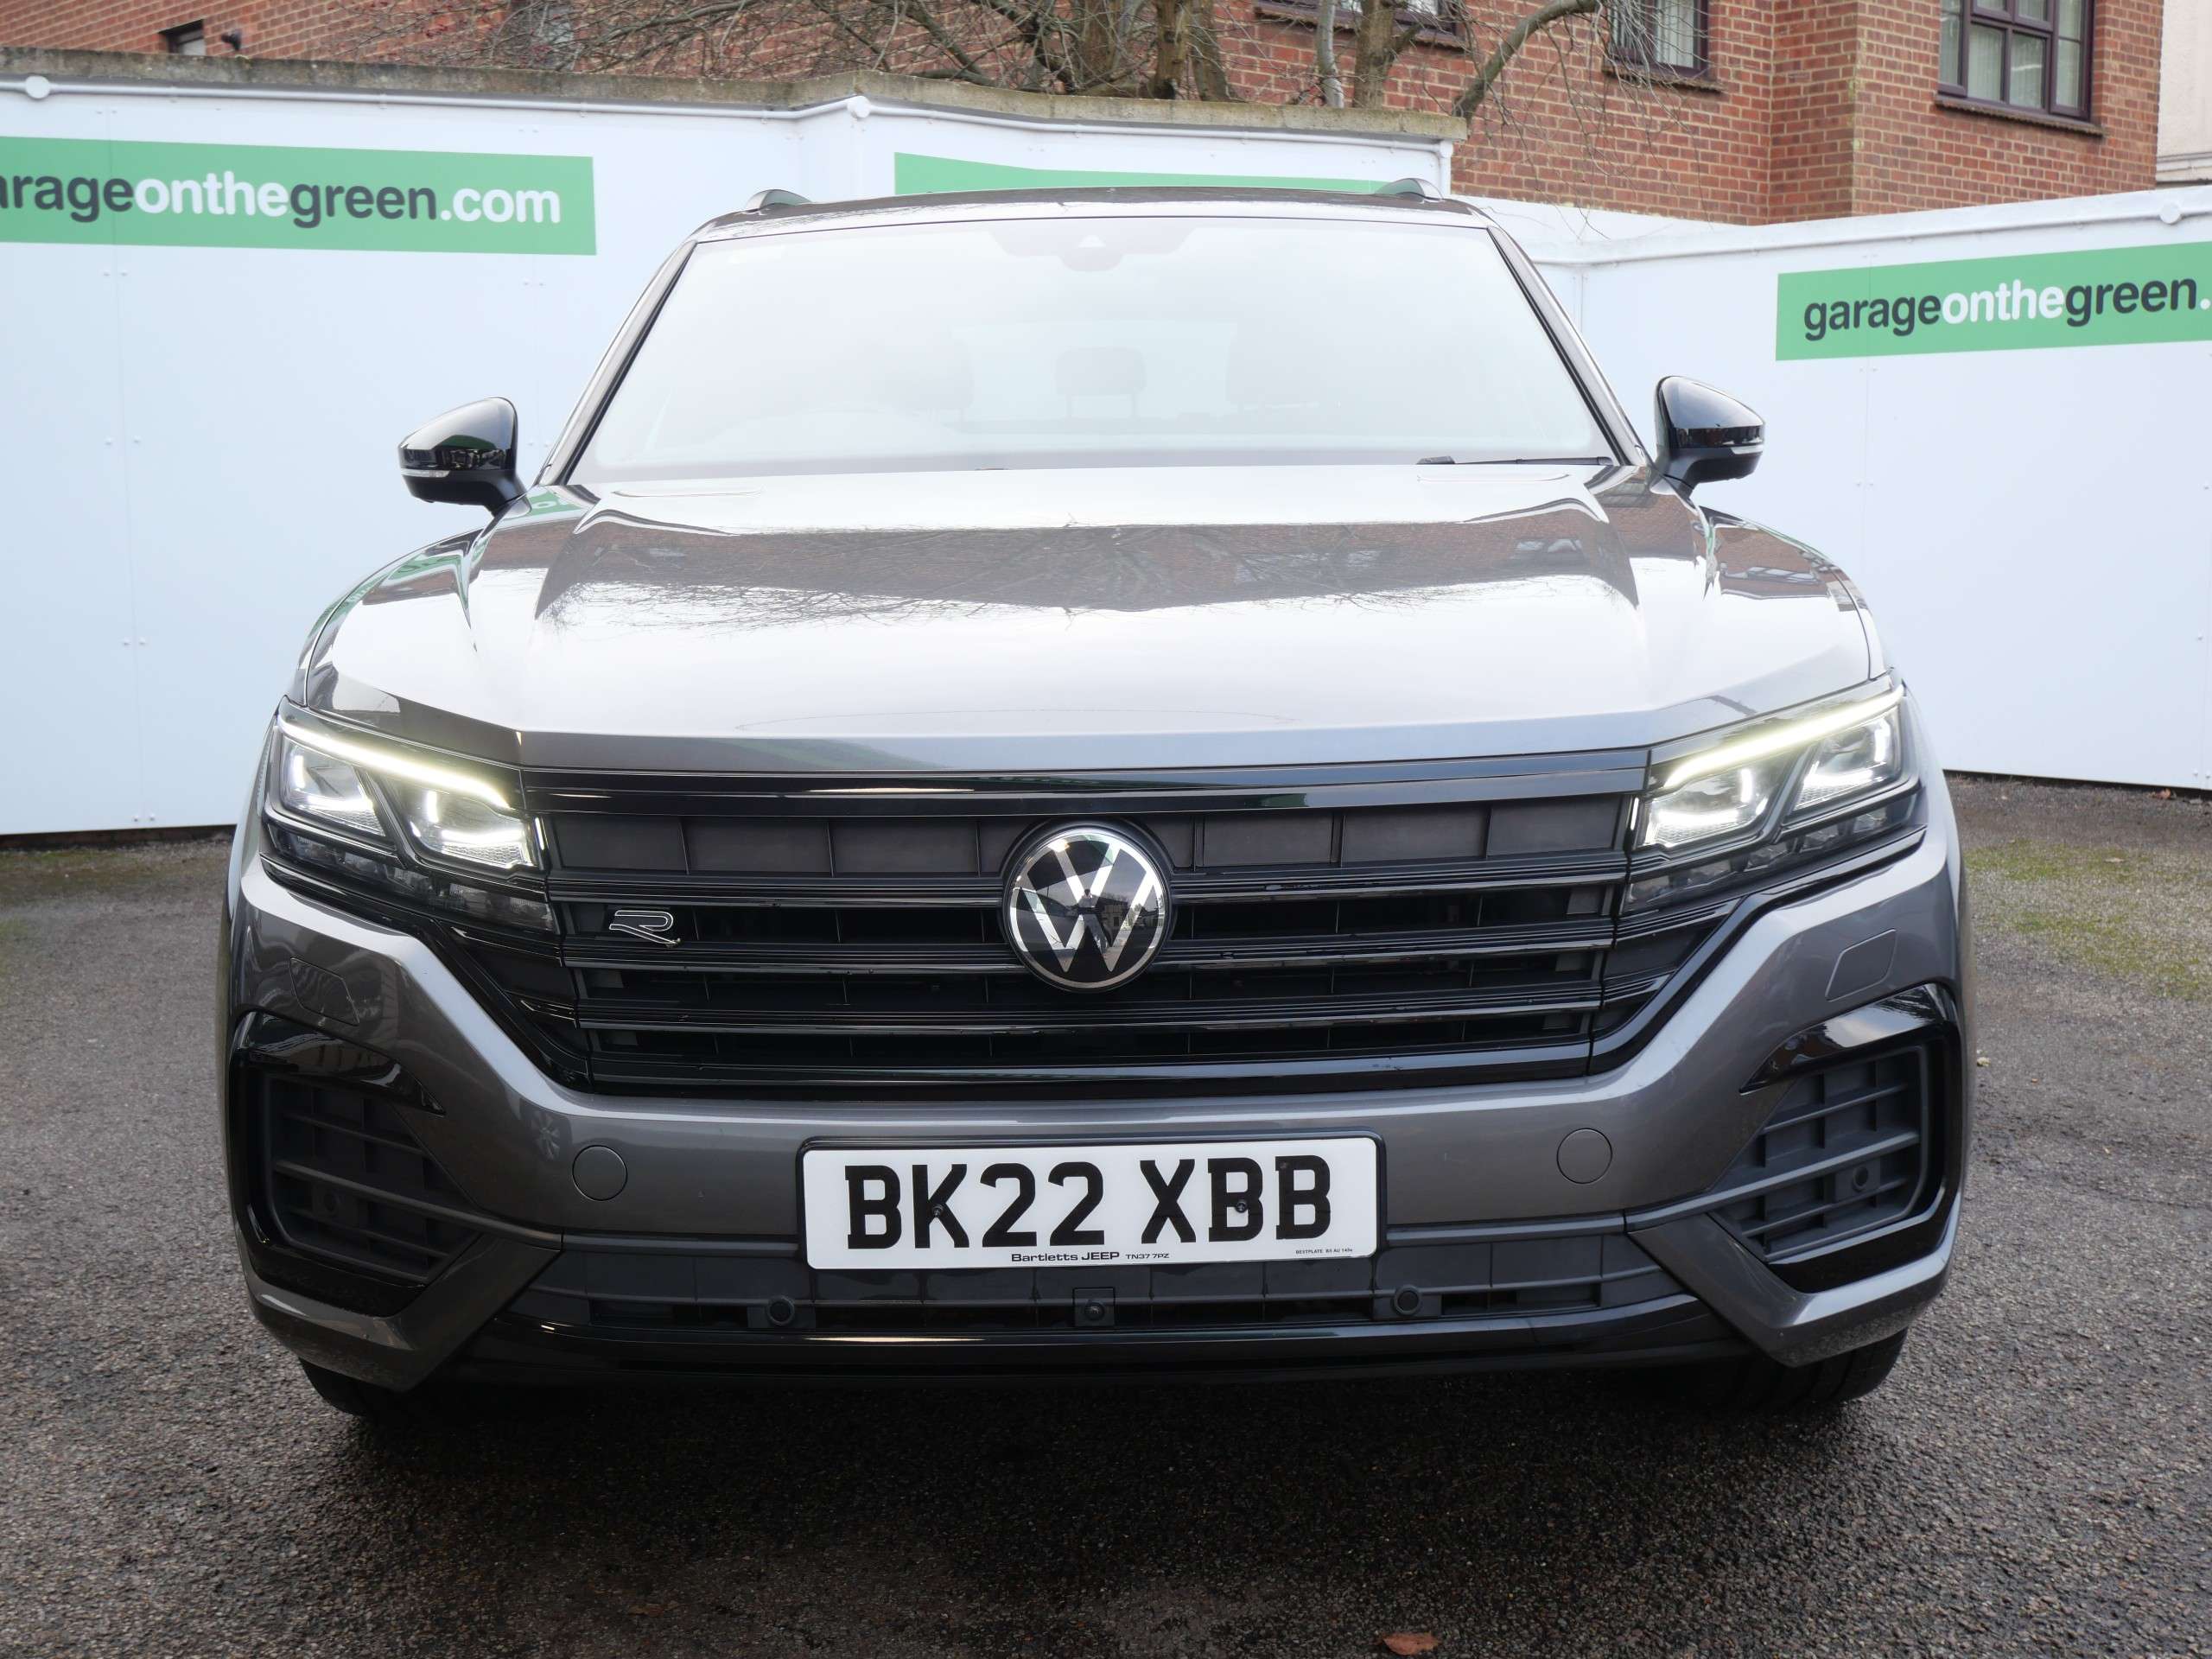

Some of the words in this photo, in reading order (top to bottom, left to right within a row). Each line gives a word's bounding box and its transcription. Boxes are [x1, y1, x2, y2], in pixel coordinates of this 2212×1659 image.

[1804, 278, 2211, 341] garageonthegreen.
[845, 1163, 1104, 1249] BK22
[1141, 1155, 1332, 1244] XBB
[1011, 1253, 1078, 1262] Bartletts
[1081, 1252, 1120, 1261] JEEP
